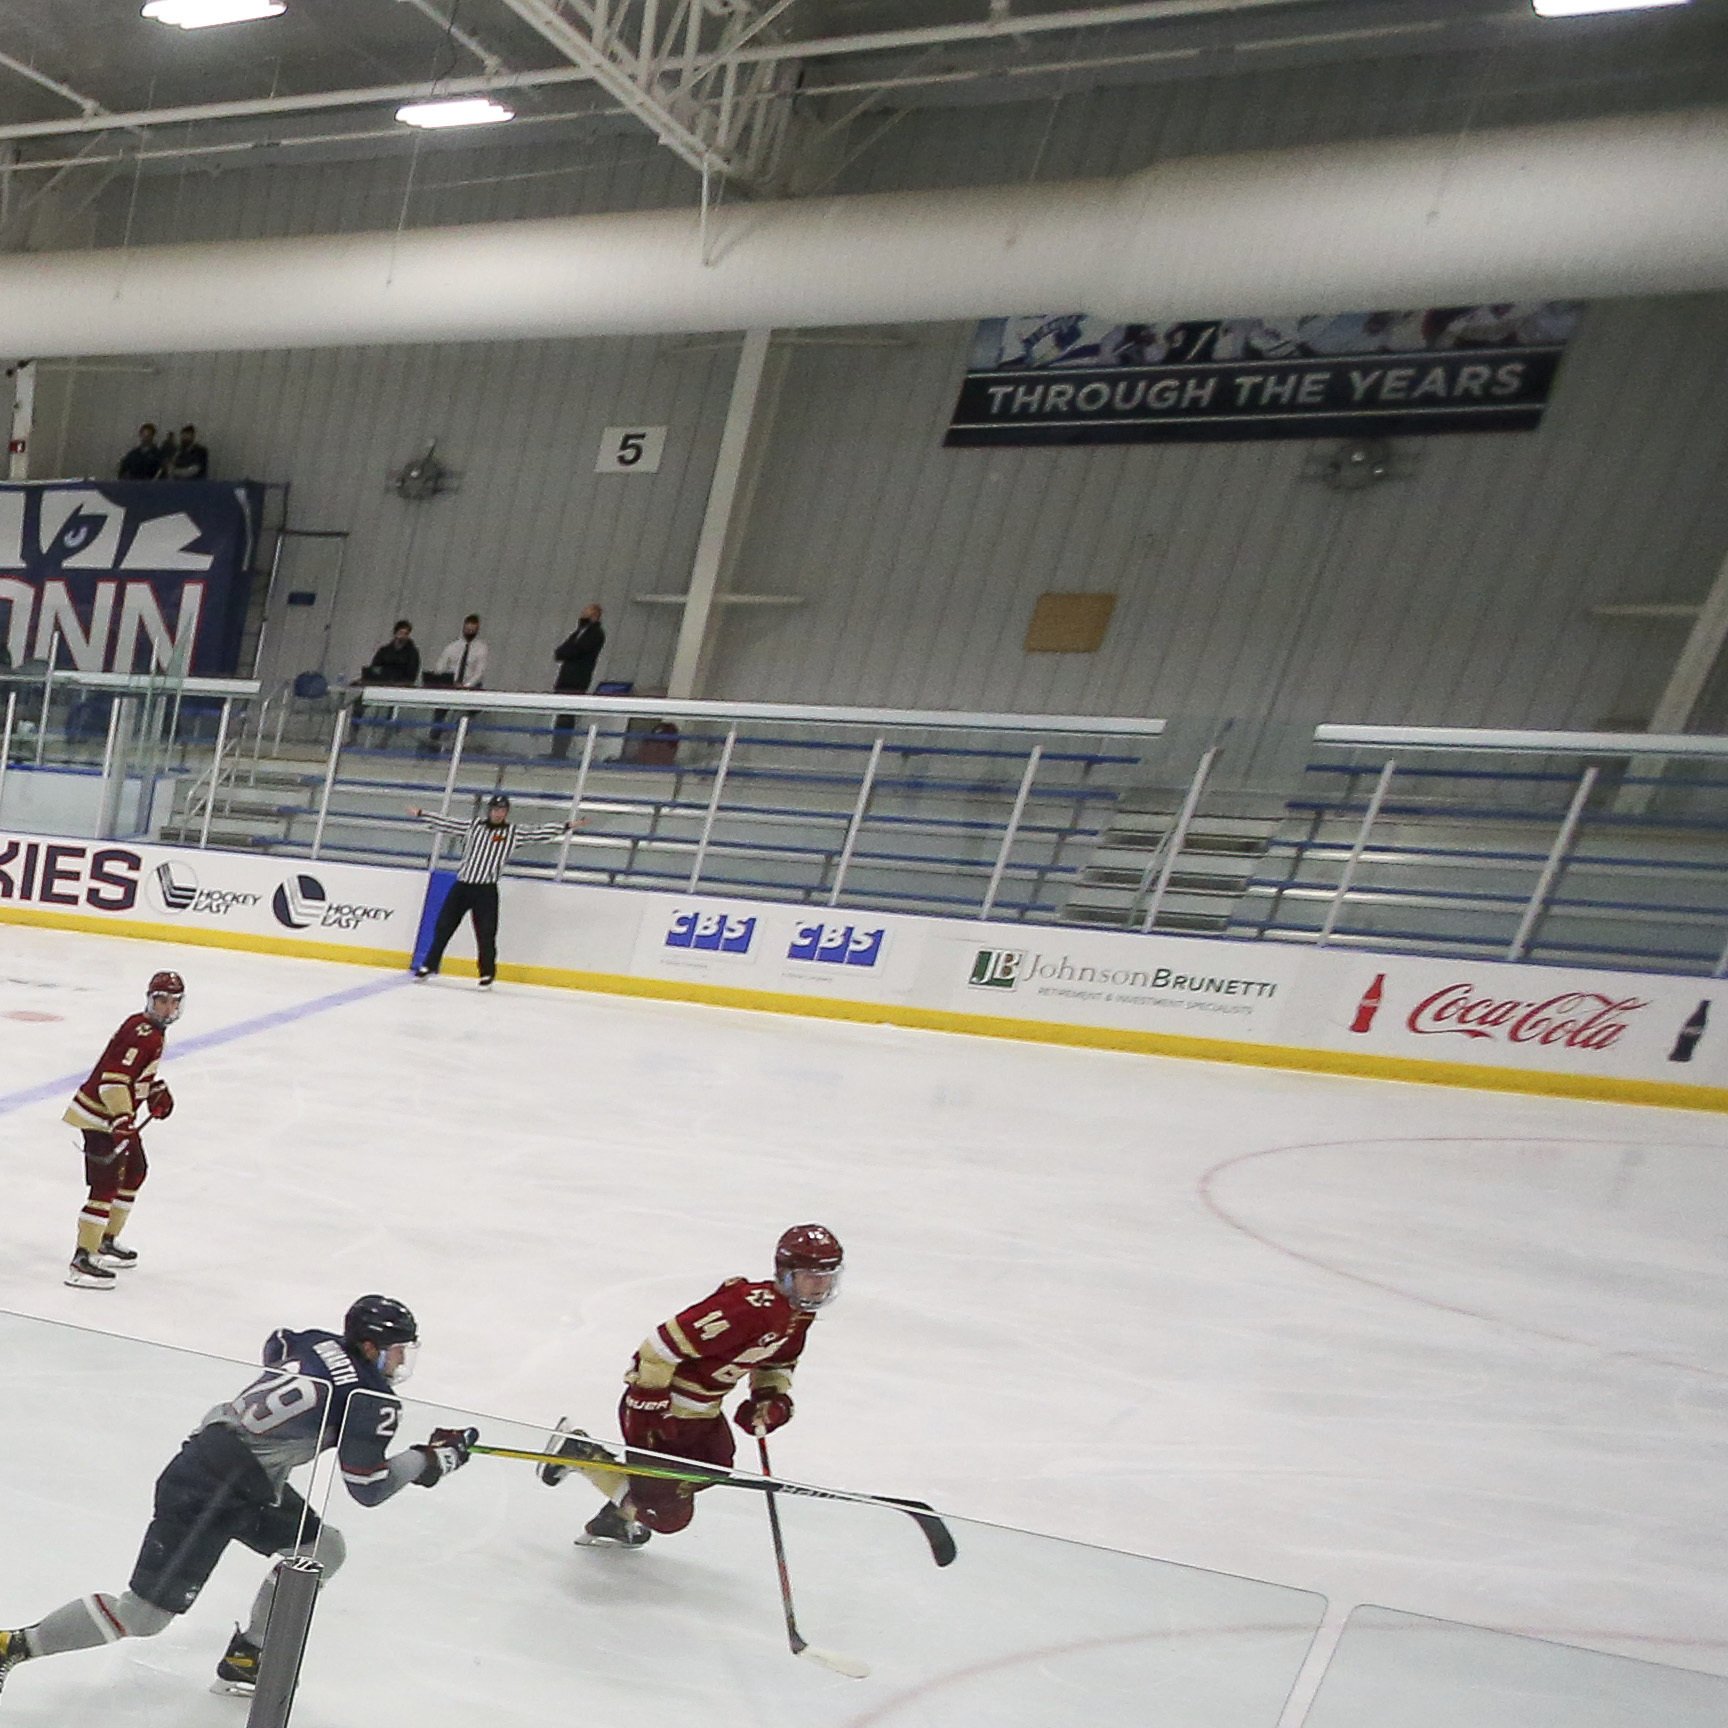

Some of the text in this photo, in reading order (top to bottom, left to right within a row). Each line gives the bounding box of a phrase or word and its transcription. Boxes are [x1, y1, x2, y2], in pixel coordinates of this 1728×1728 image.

[987, 362, 1527, 415] THROUGH THE YEARS
[616, 432, 646, 465] 5
[197, 888, 262, 906] HOCKEY
[326, 902, 394, 921] HOCKEY
[666, 909, 757, 951] CBS
[787, 921, 885, 964] CBS
[1407, 983, 1648, 1051] Coca-Cola
[693, 1310, 731, 1341] 14
[231, 1359, 319, 1436] 29
